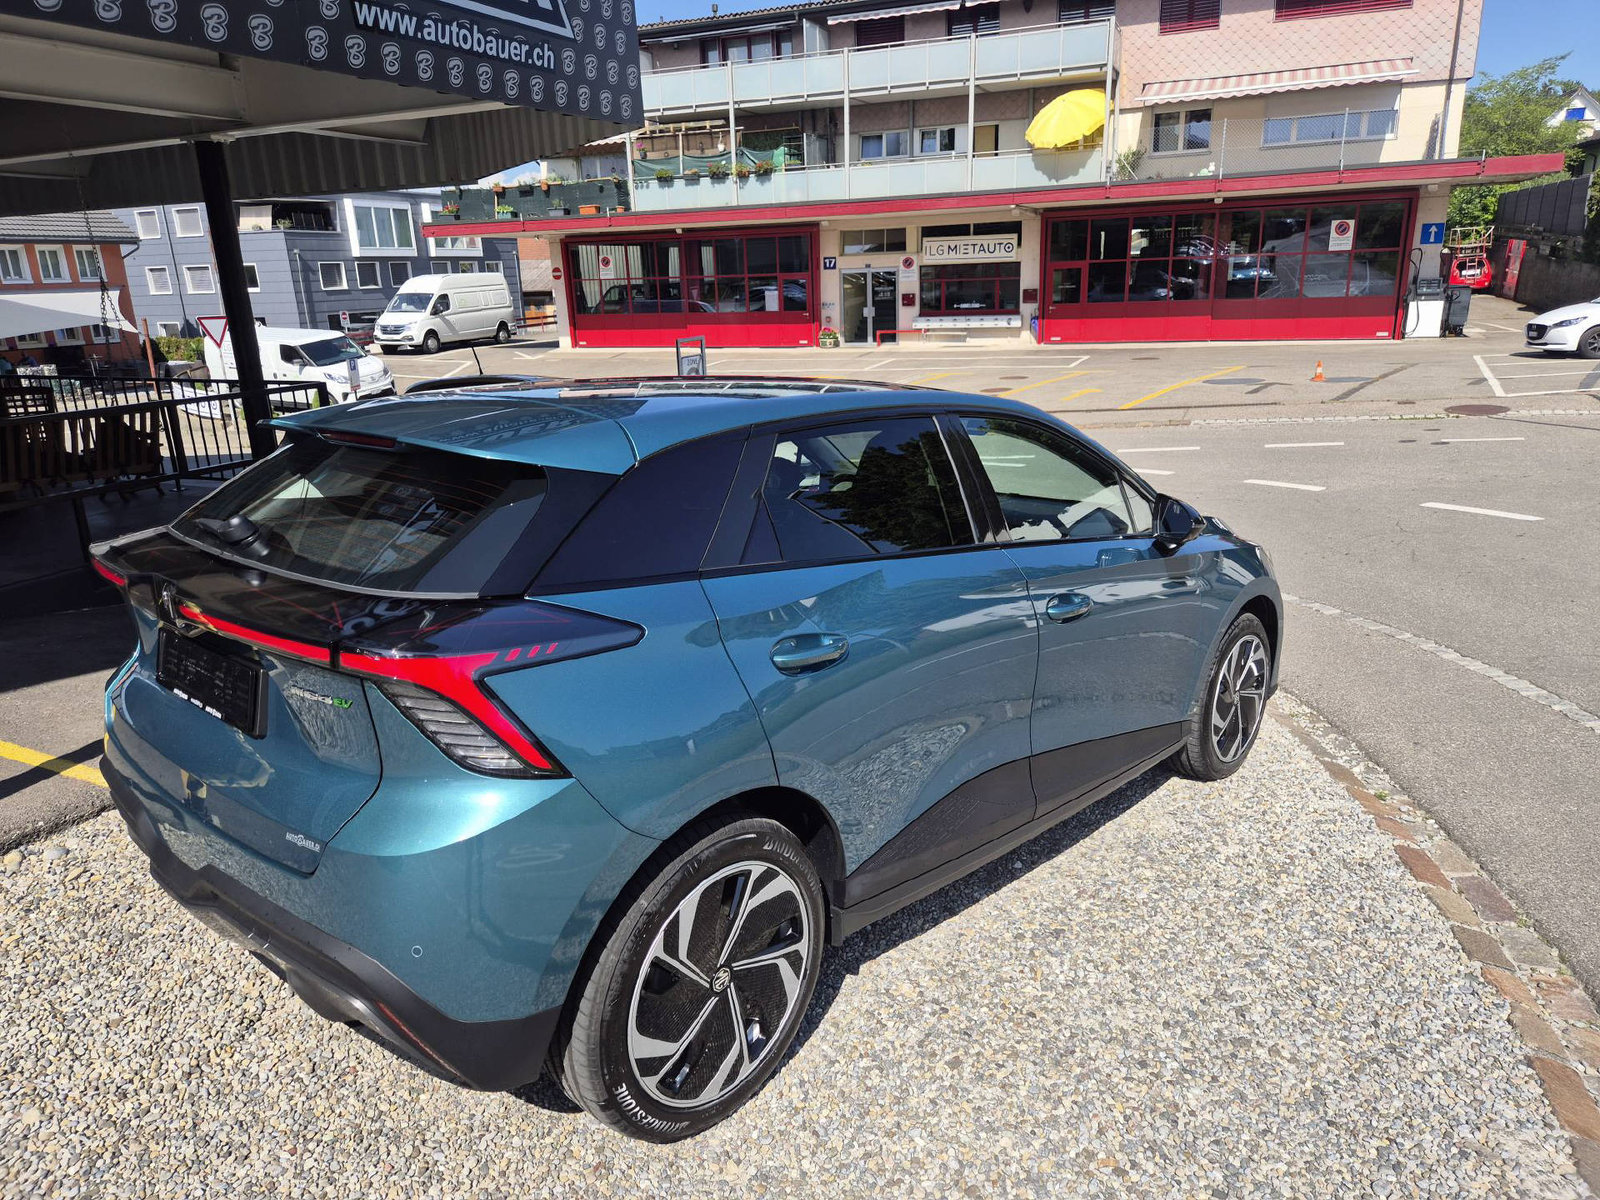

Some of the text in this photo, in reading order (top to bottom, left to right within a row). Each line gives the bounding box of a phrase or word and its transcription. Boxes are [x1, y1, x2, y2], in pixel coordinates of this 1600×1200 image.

[354, 2, 555, 69] www.autobauer.ch
[924, 242, 1014, 256] ILG MIETAUTO
[824, 258, 836, 268] 17
